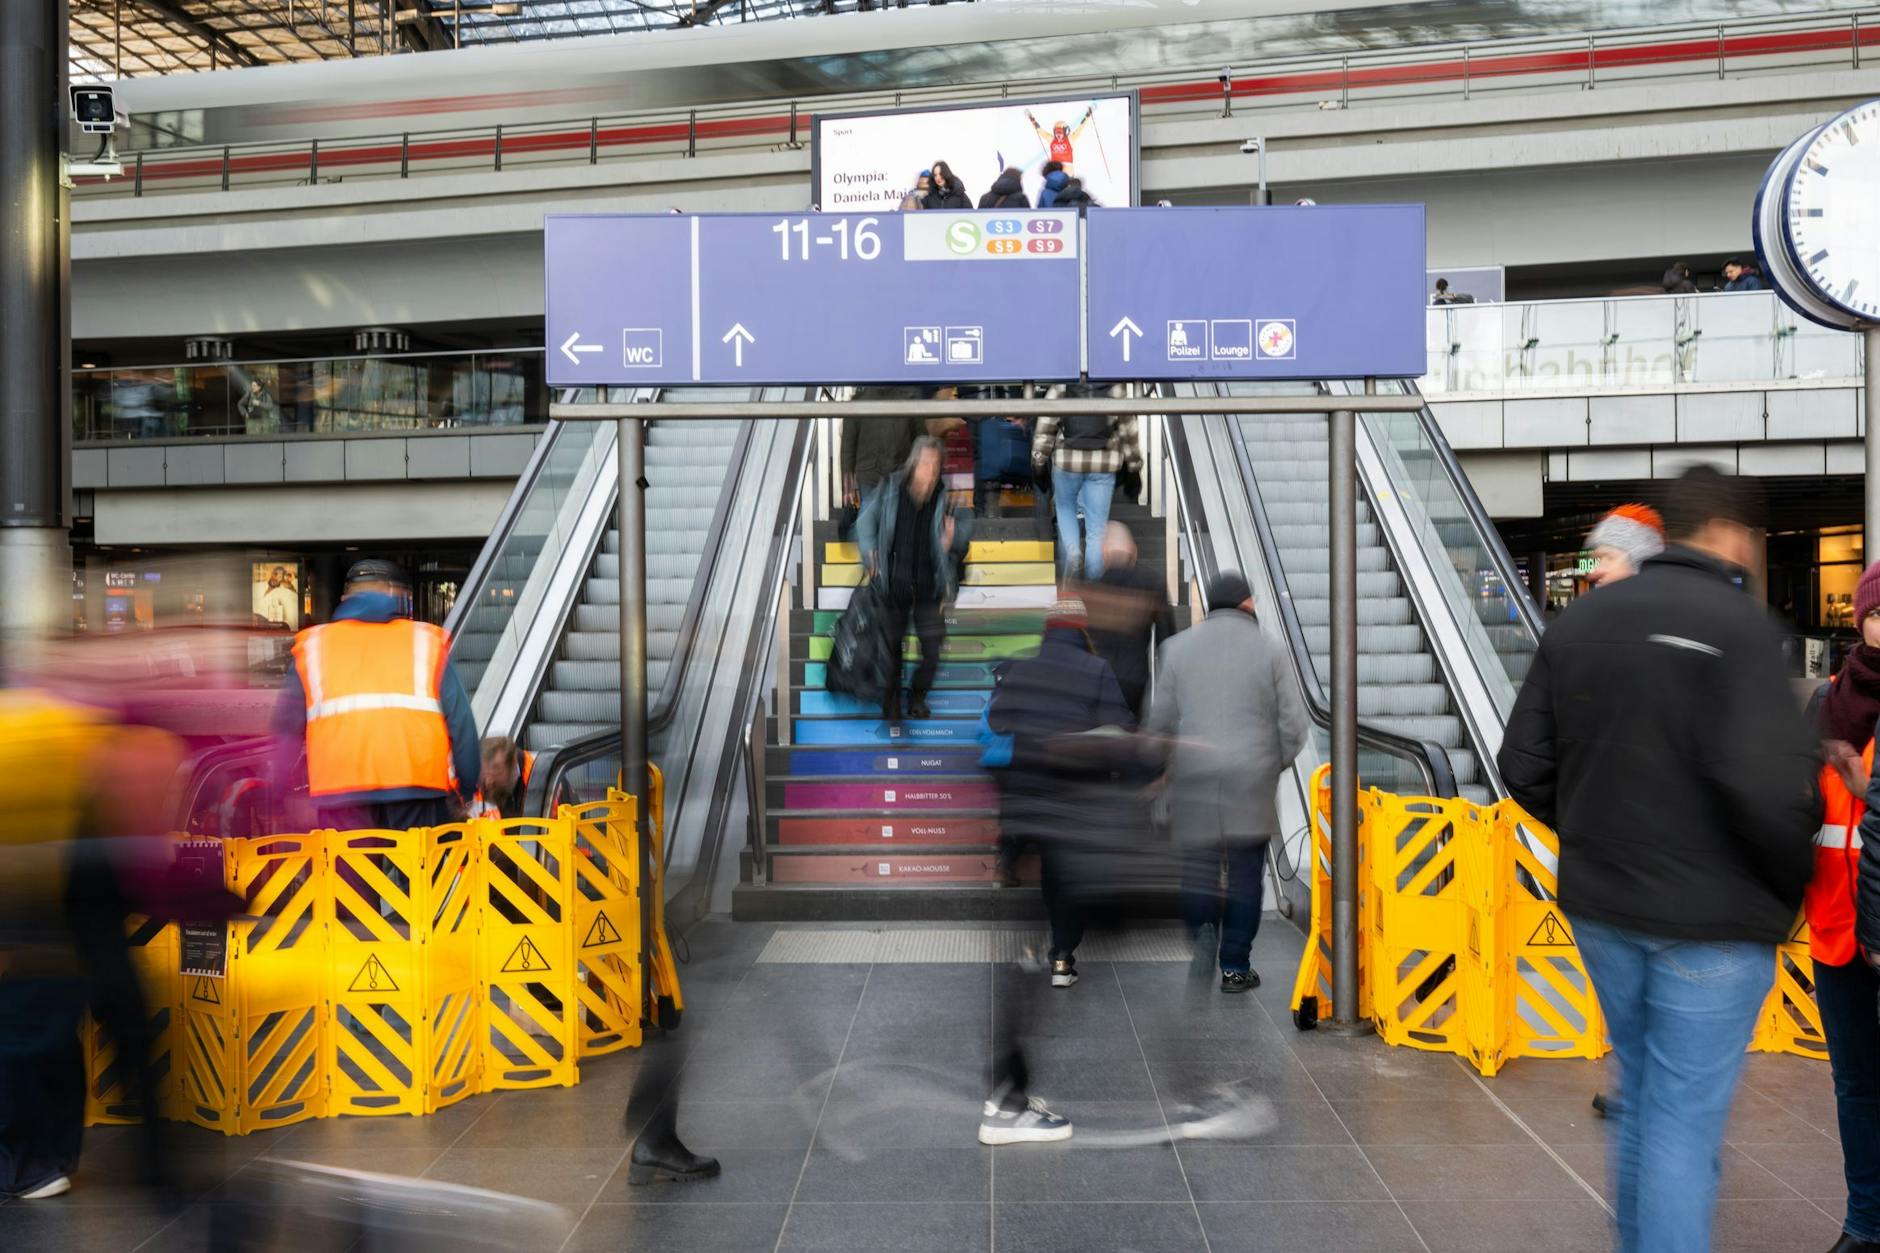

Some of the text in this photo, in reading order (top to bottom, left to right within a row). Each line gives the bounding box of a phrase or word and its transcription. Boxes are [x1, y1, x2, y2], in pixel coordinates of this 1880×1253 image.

[833, 128, 852, 136] Sport
[833, 171, 888, 186] Olympia:
[833, 190, 880, 204] Daniela
[773, 217, 882, 261] 11-16
[626, 346, 654, 363] WC
[1170, 345, 1200, 356] Polizei
[1214, 345, 1249, 357] Lounge
[920, 759, 942, 767] NUGAT
[911, 827, 946, 835] VOLL-NUSS
[898, 863, 950, 873] KAKAO-MOUSSE
